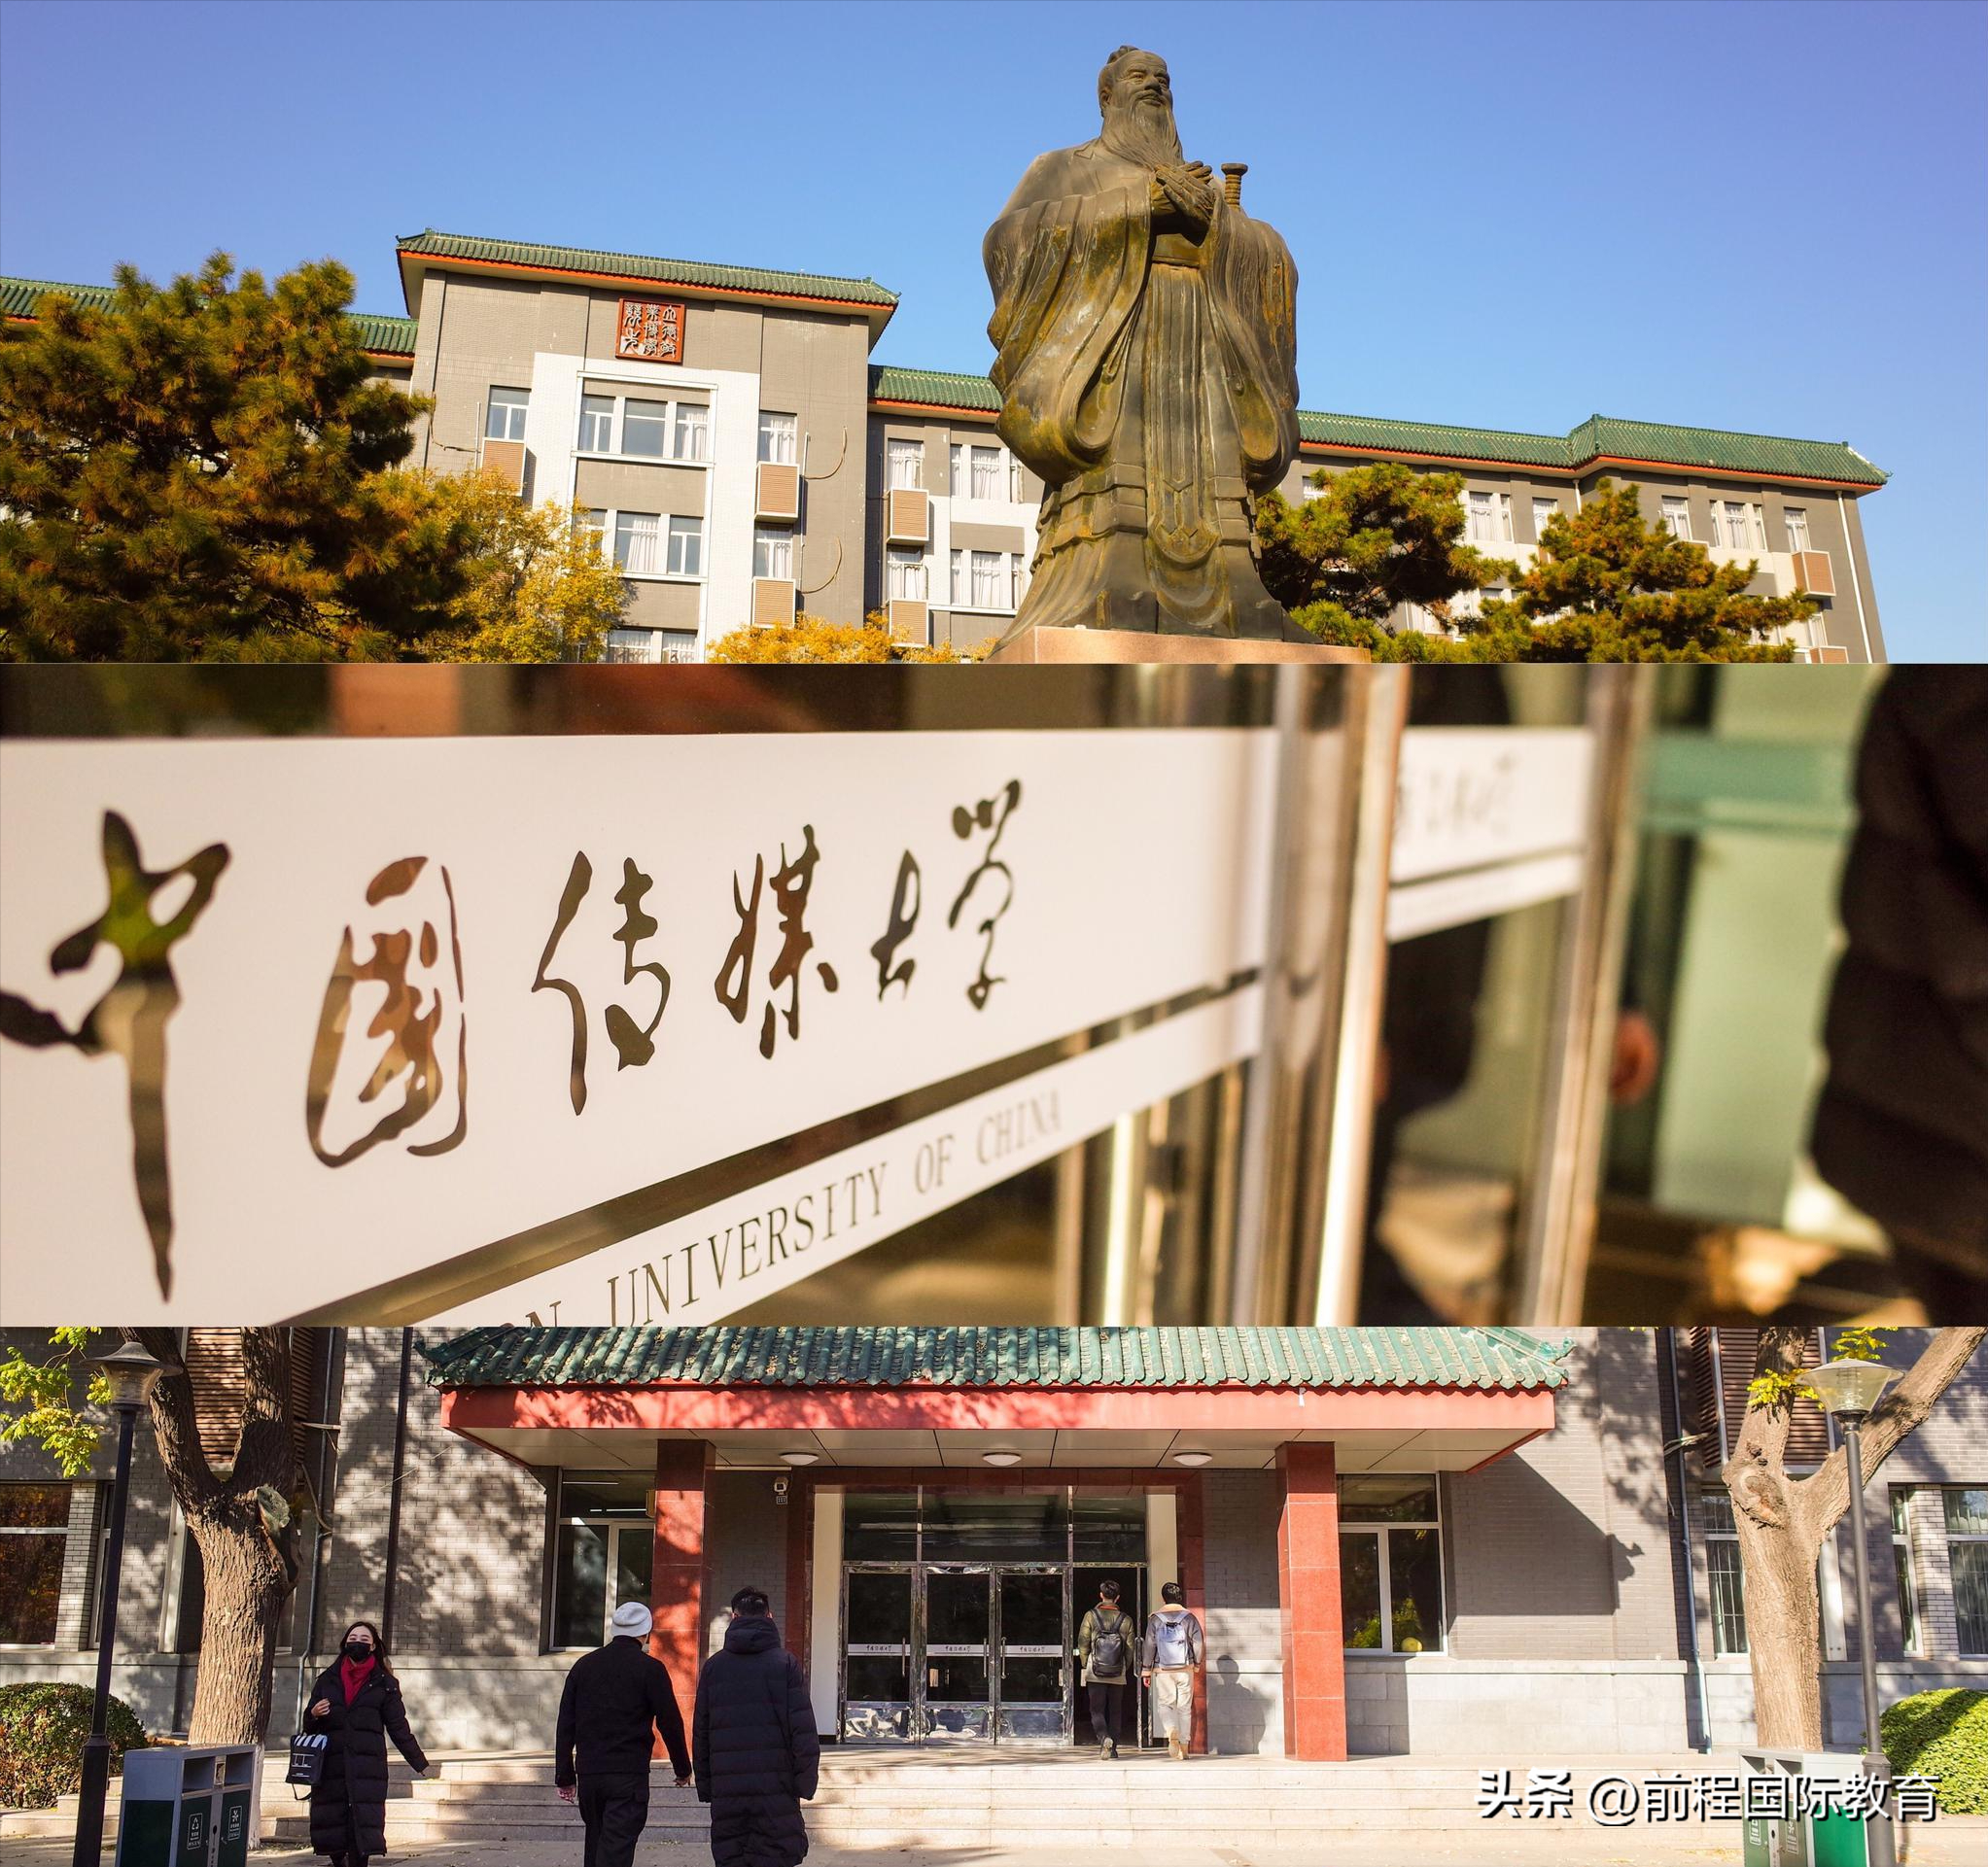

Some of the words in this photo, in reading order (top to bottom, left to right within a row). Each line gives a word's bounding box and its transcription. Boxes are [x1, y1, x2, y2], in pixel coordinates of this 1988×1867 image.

[608, 1161, 887, 1327] UNIVERSITY
[914, 1133, 955, 1194] OF
[977, 1087, 1062, 1165] CHINA
